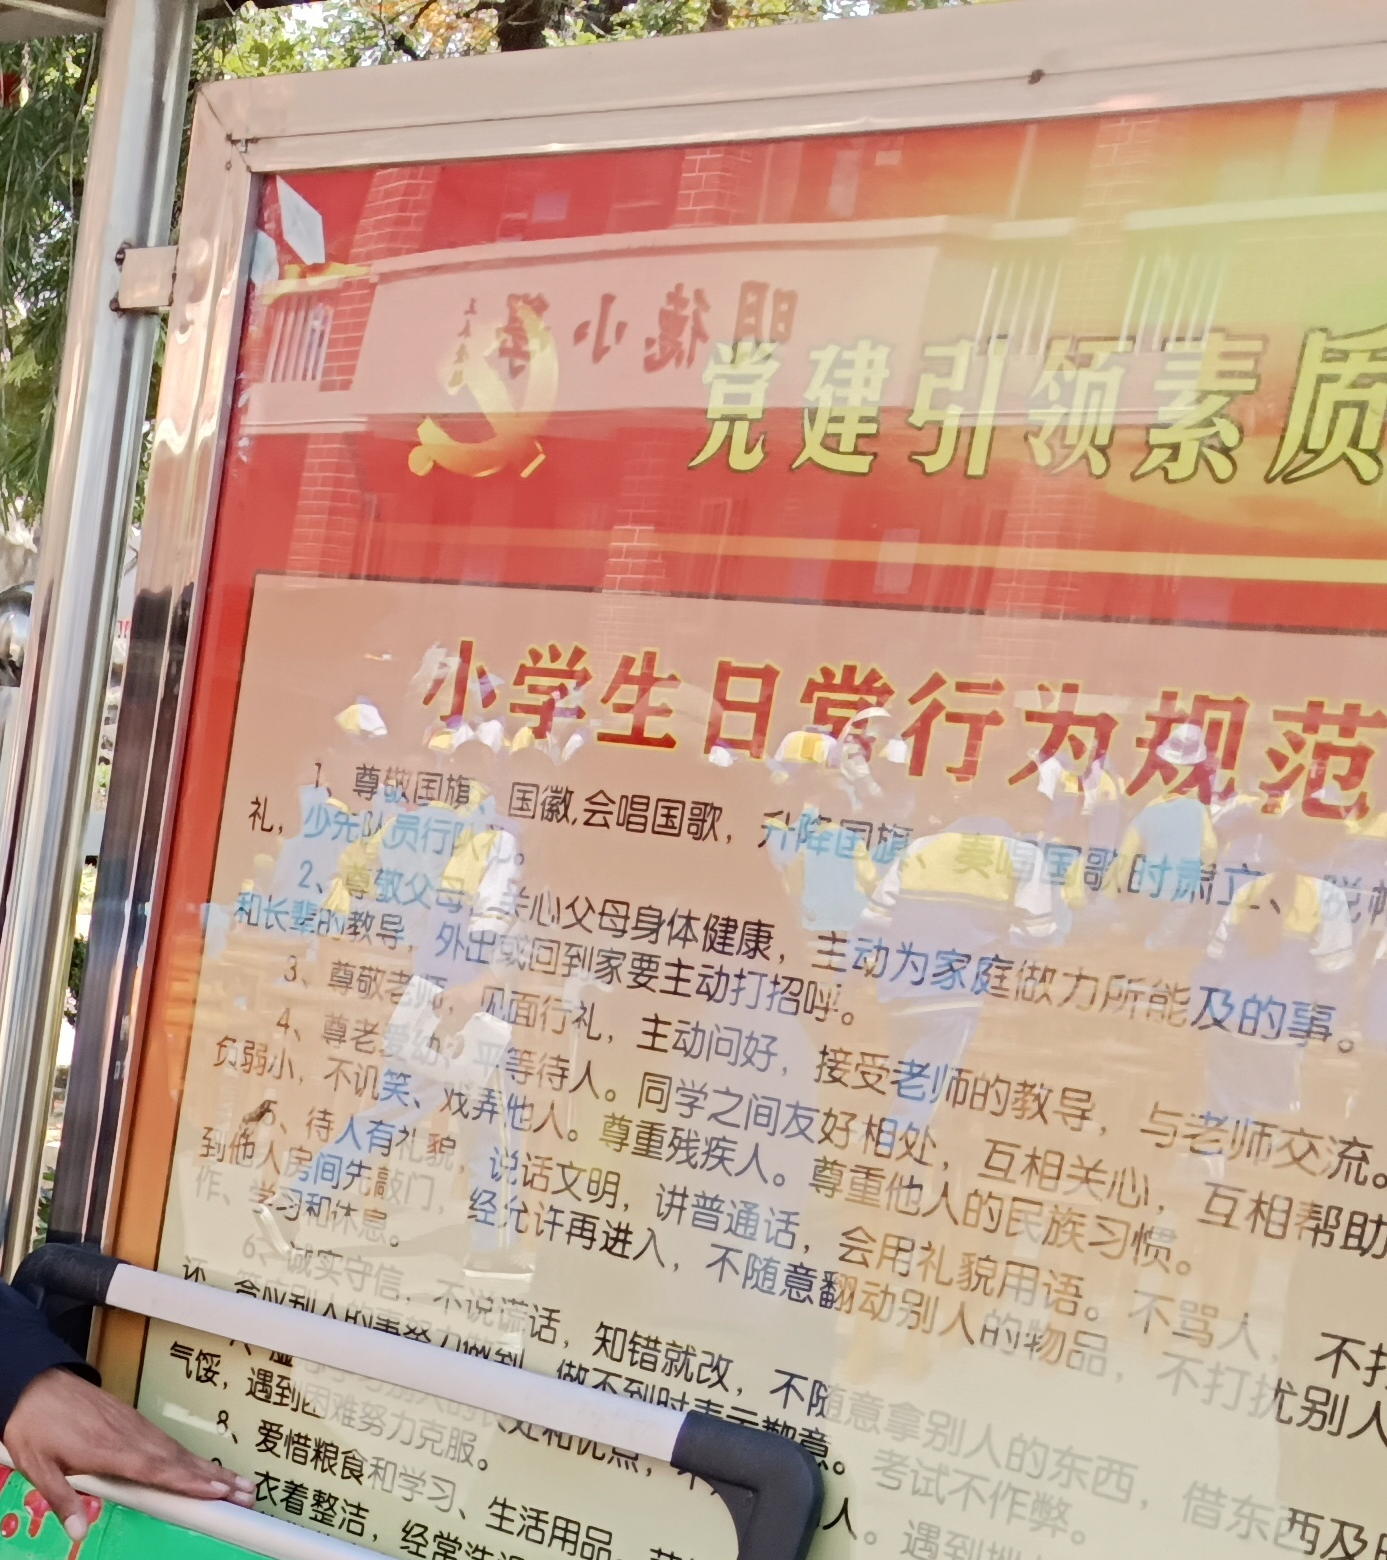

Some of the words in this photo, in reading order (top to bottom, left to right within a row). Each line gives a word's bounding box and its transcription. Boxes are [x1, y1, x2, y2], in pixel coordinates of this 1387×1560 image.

[687, 323, 1387, 485] 党建引领素质
[420, 636, 1377, 820] 小学生日常行为规范
